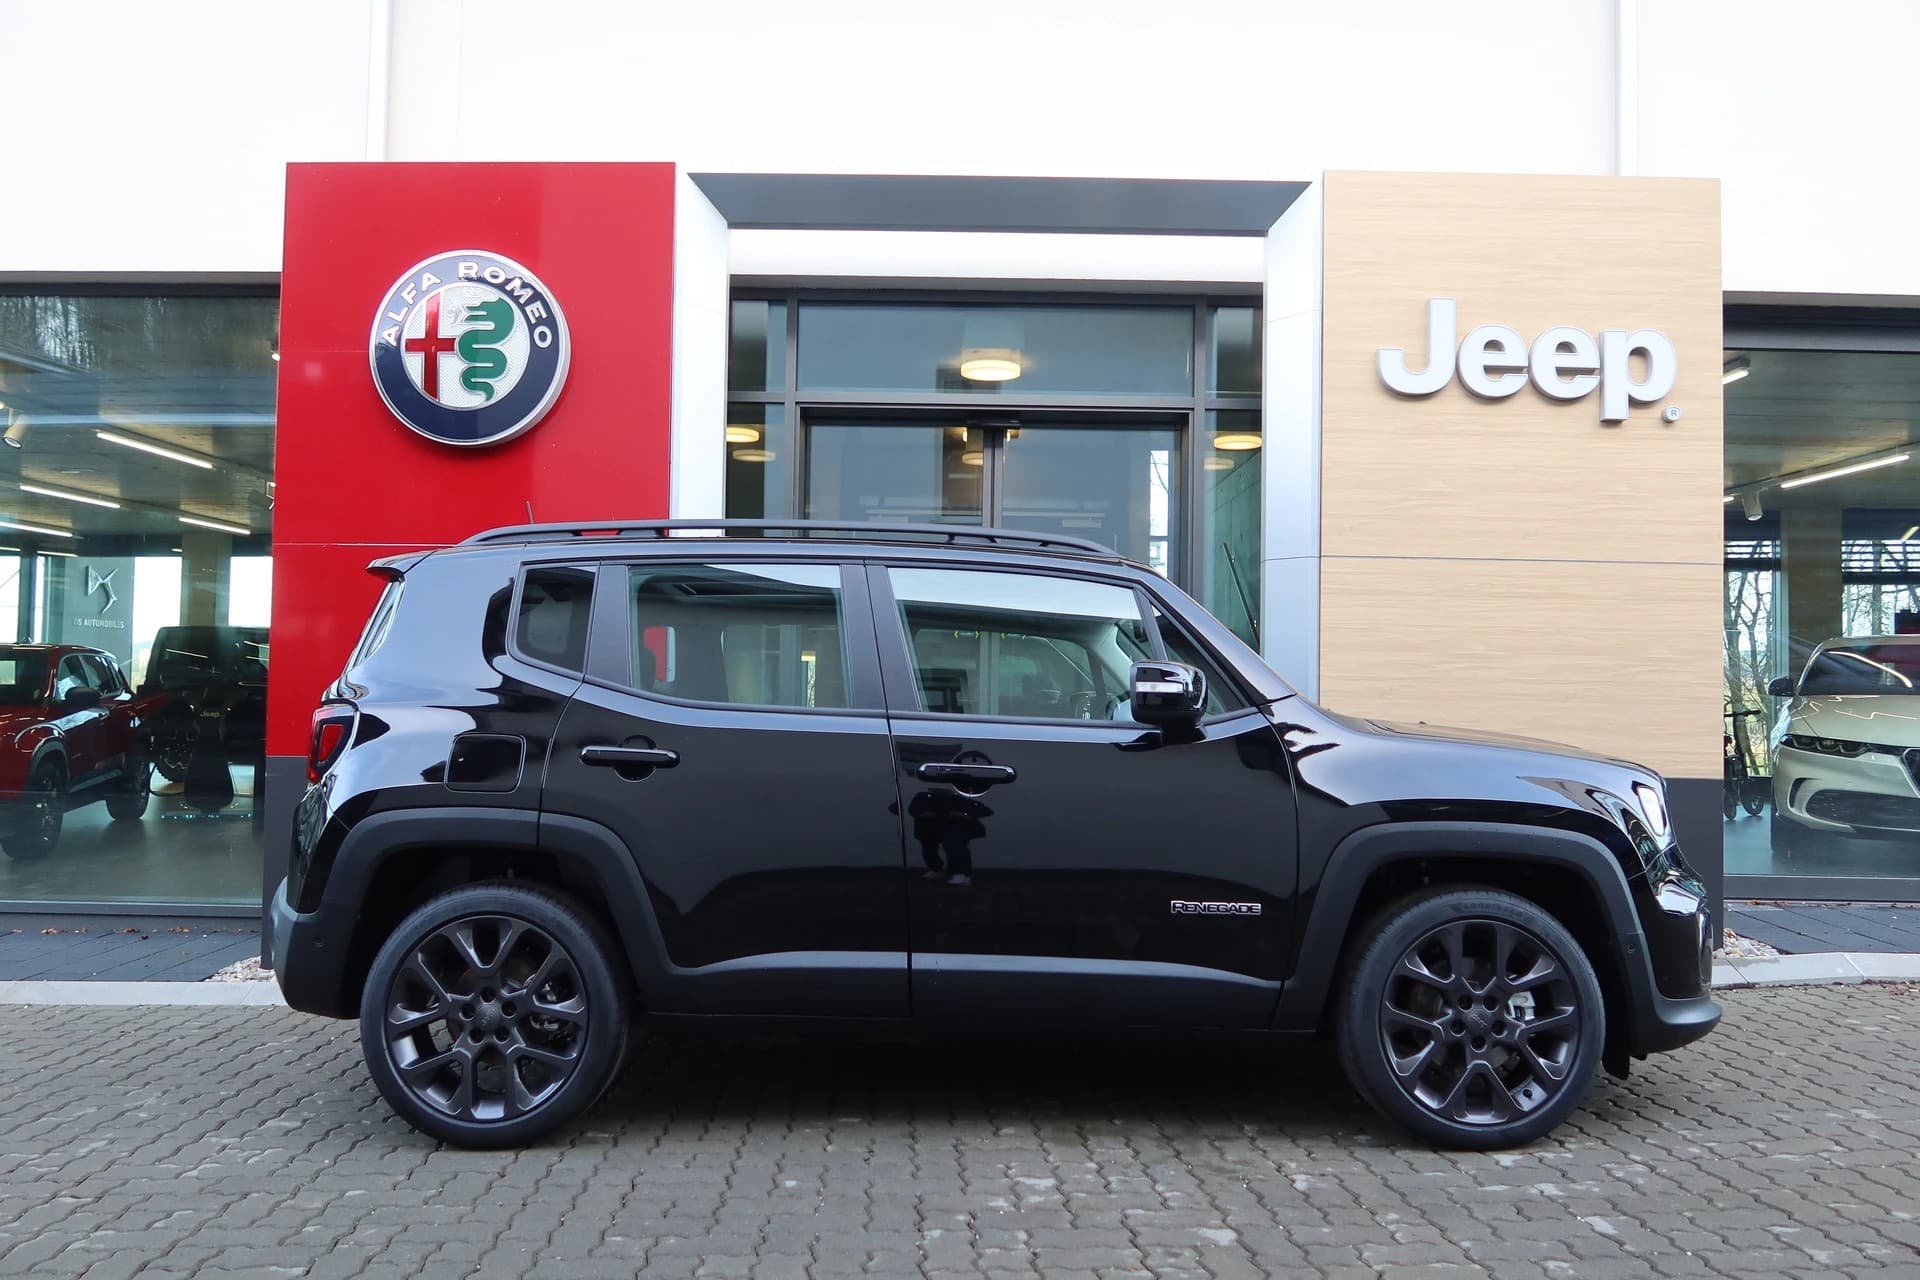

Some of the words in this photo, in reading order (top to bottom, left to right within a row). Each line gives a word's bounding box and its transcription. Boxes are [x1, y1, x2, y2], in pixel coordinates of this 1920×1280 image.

[382, 271, 442, 347] ALFA
[458, 261, 553, 349] ROMEO
[1376, 296, 1678, 425] Jeep
[1170, 900, 1262, 916] RENEGADE
